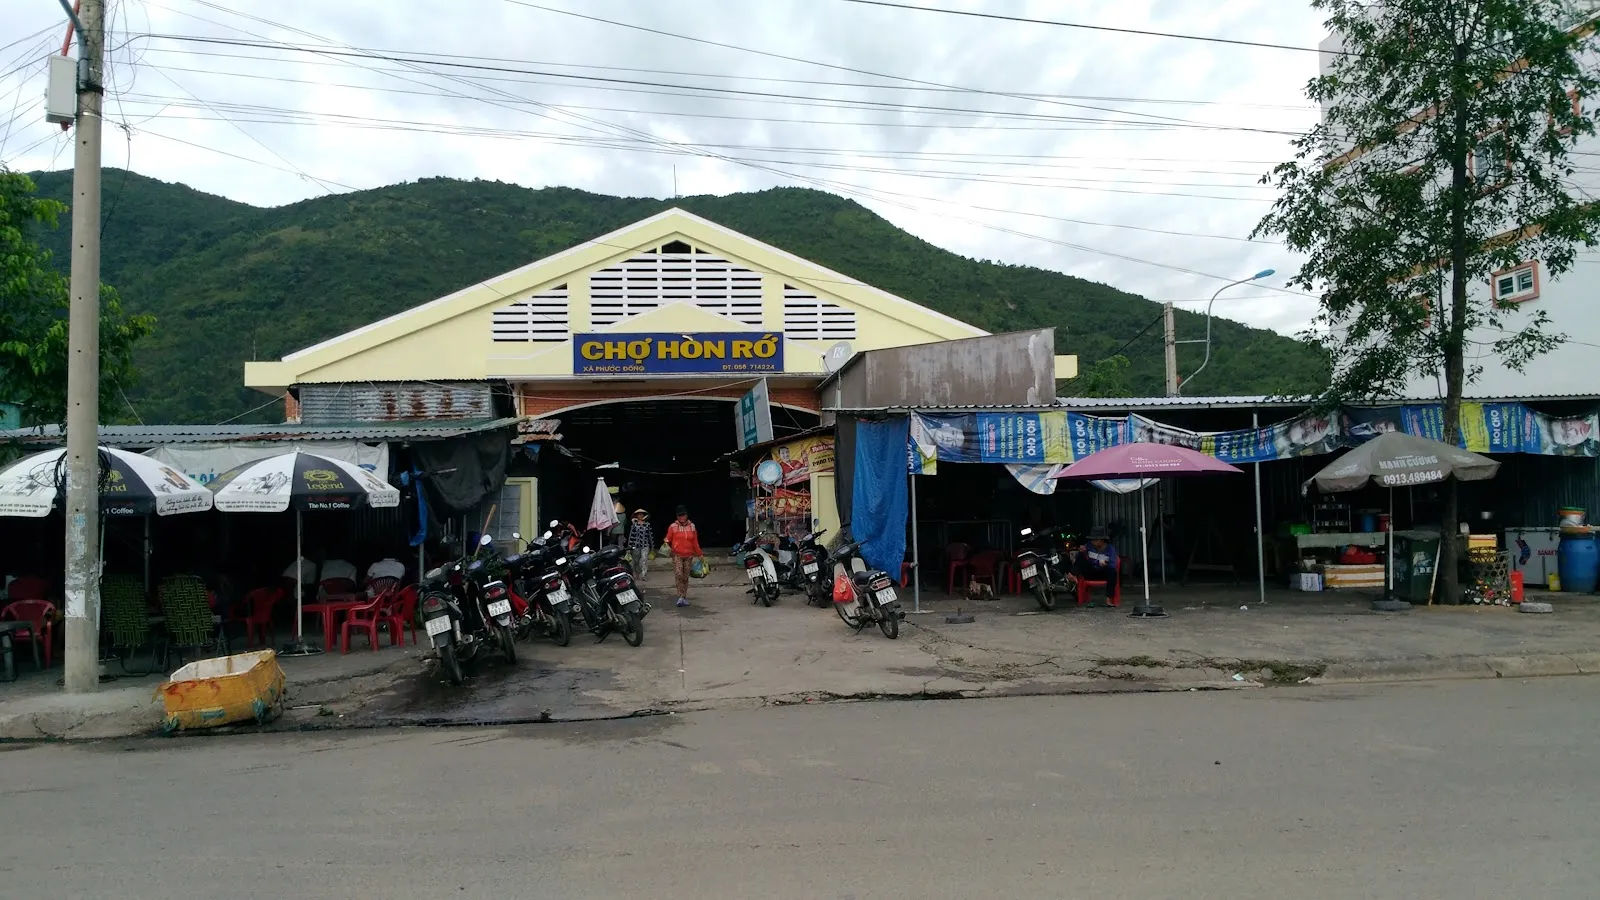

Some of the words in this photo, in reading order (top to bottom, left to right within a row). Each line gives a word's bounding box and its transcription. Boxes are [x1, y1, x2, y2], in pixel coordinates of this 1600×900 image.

[581, 337, 653, 364] CHỢ
[657, 334, 725, 360] HÒN
[732, 333, 779, 359] RỚ
[1383, 470, 1443, 485] 0913.489484
[307, 482, 344, 490] Legend
[110, 507, 134, 515] Coffee
